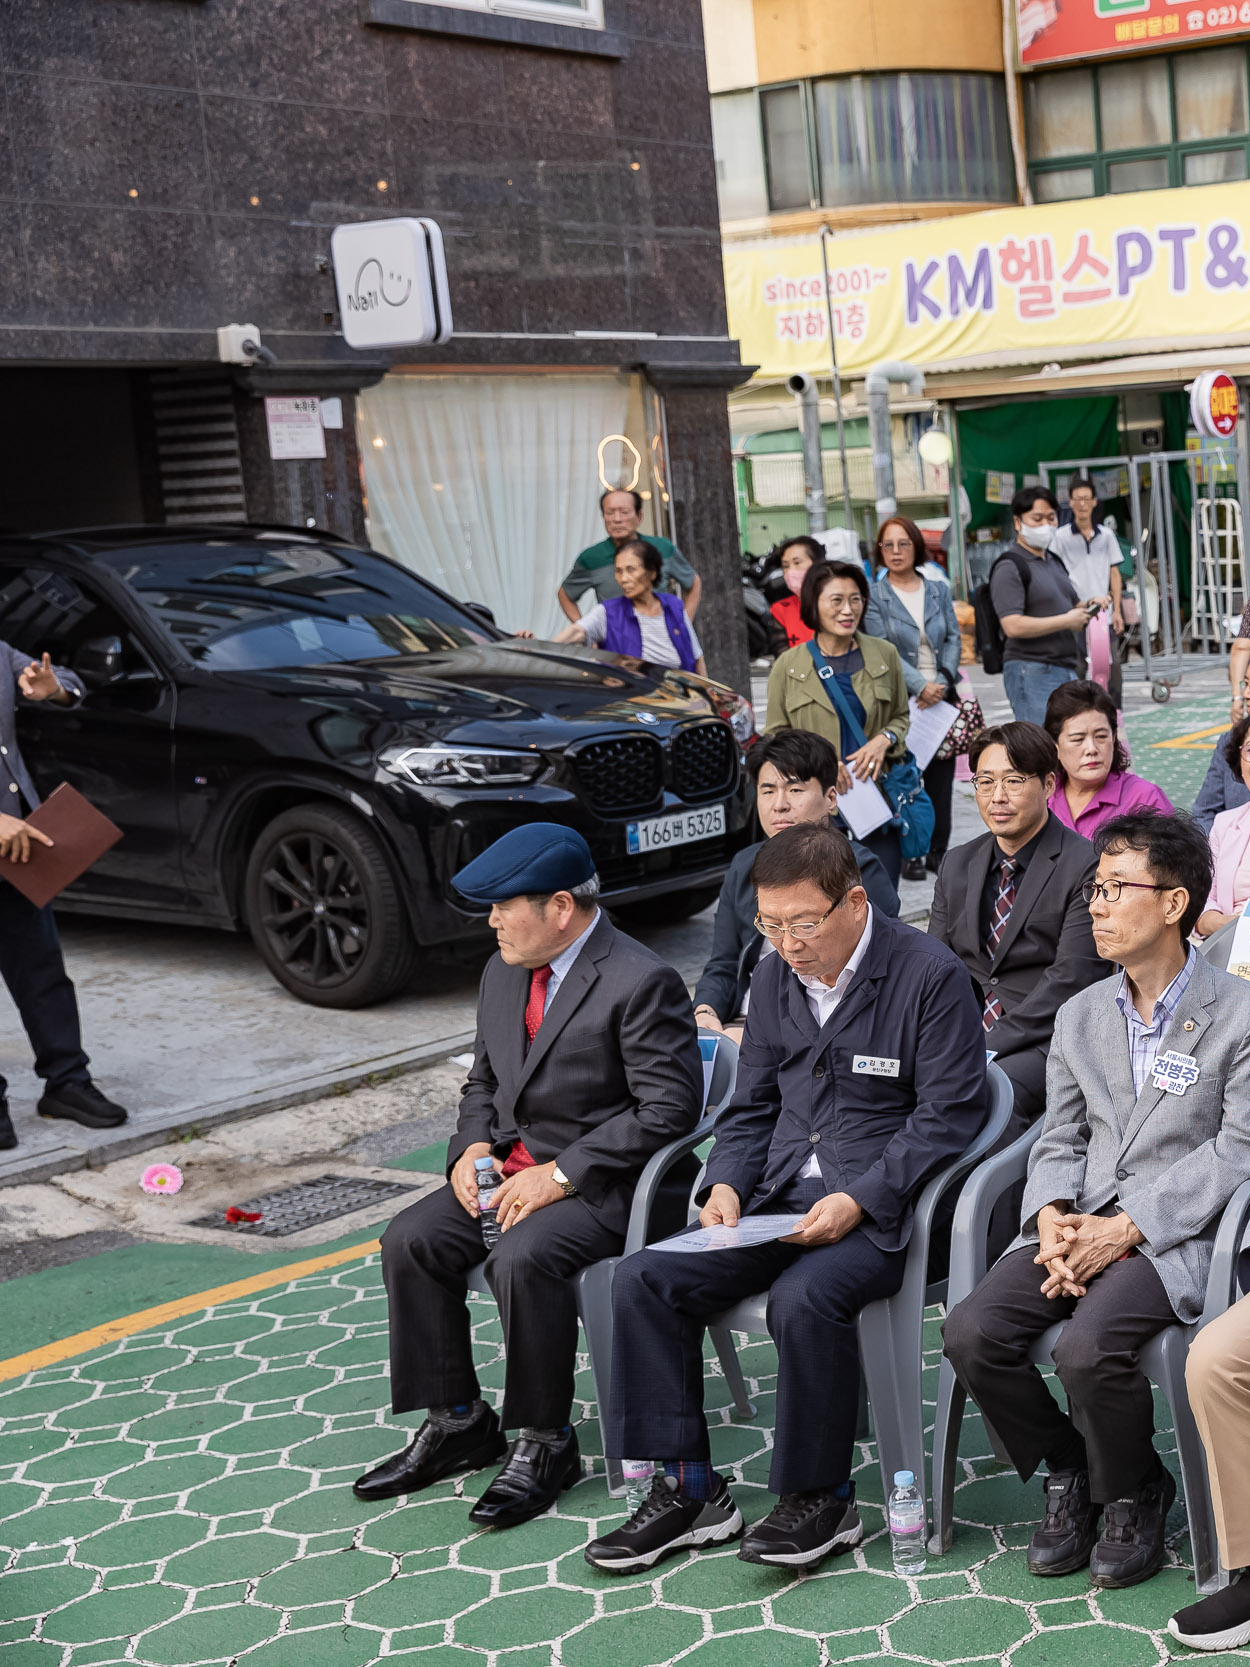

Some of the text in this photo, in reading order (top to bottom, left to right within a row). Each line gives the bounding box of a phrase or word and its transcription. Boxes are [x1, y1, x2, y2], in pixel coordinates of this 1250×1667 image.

[347, 291, 379, 312] Nail
[779, 311, 824, 340] 지하
[642, 810, 722, 847] 166버 5325
[1154, 1058, 1197, 1083] 전병주
[1166, 1053, 1193, 1065] 서울시의원
[1168, 1081, 1185, 1092] 광진
